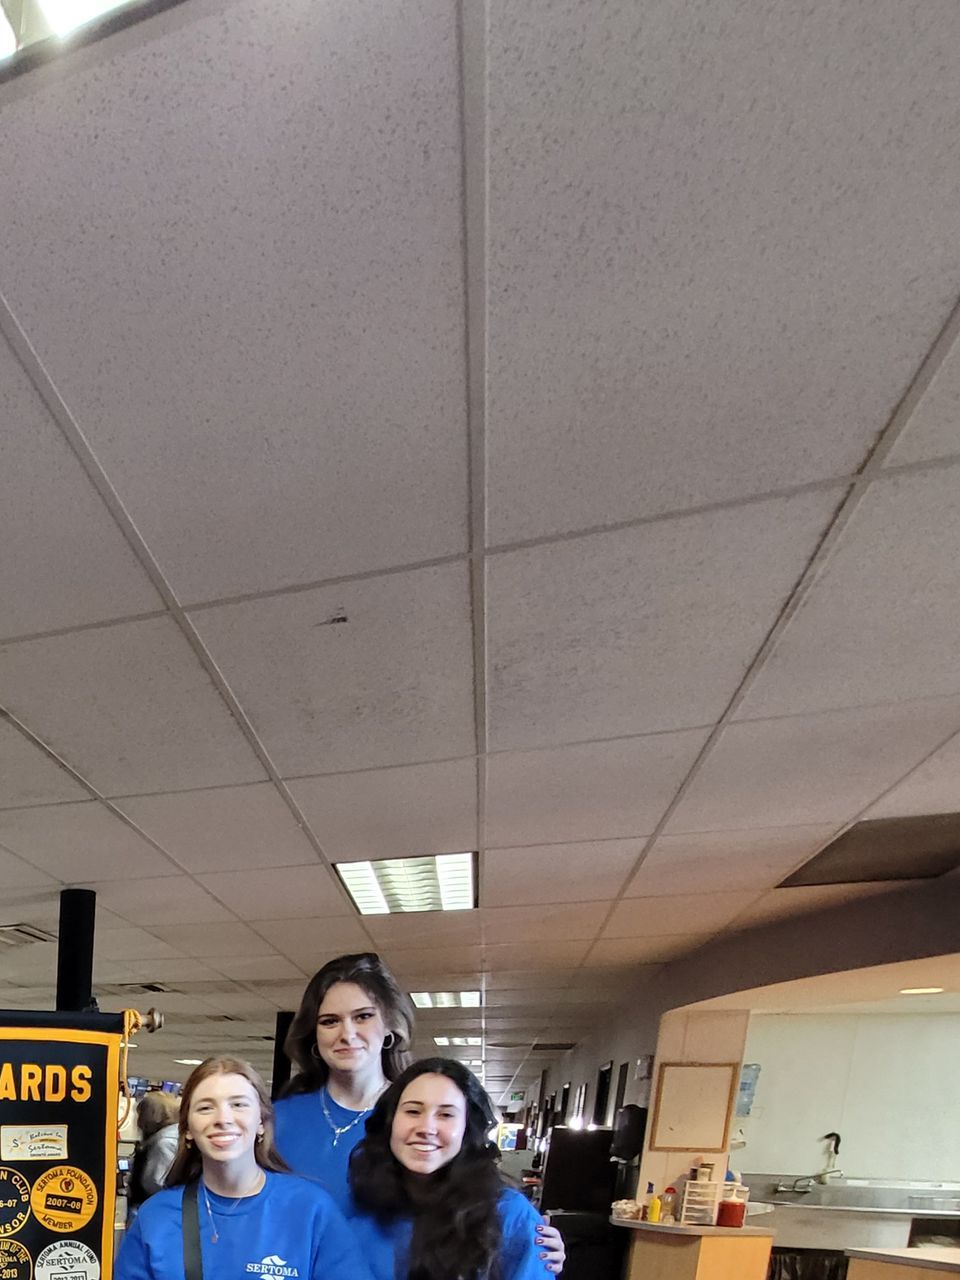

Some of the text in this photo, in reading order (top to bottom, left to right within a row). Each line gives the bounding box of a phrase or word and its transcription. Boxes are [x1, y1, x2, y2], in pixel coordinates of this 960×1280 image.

[11, 1175, 29, 1202] CLUB
[36, 1168, 94, 1206] SERTOMA FOUNDATION
[46, 1197, 81, 1210] 2007-08
[41, 1214, 74, 1230] MEMBER
[10, 1243, 22, 1253] OF
[16, 1248, 29, 1264] THE
[36, 1245, 58, 1268] SERTOMA
[45, 1257, 89, 1266] SERTOMA
[246, 1263, 299, 1277] SERTOMA
